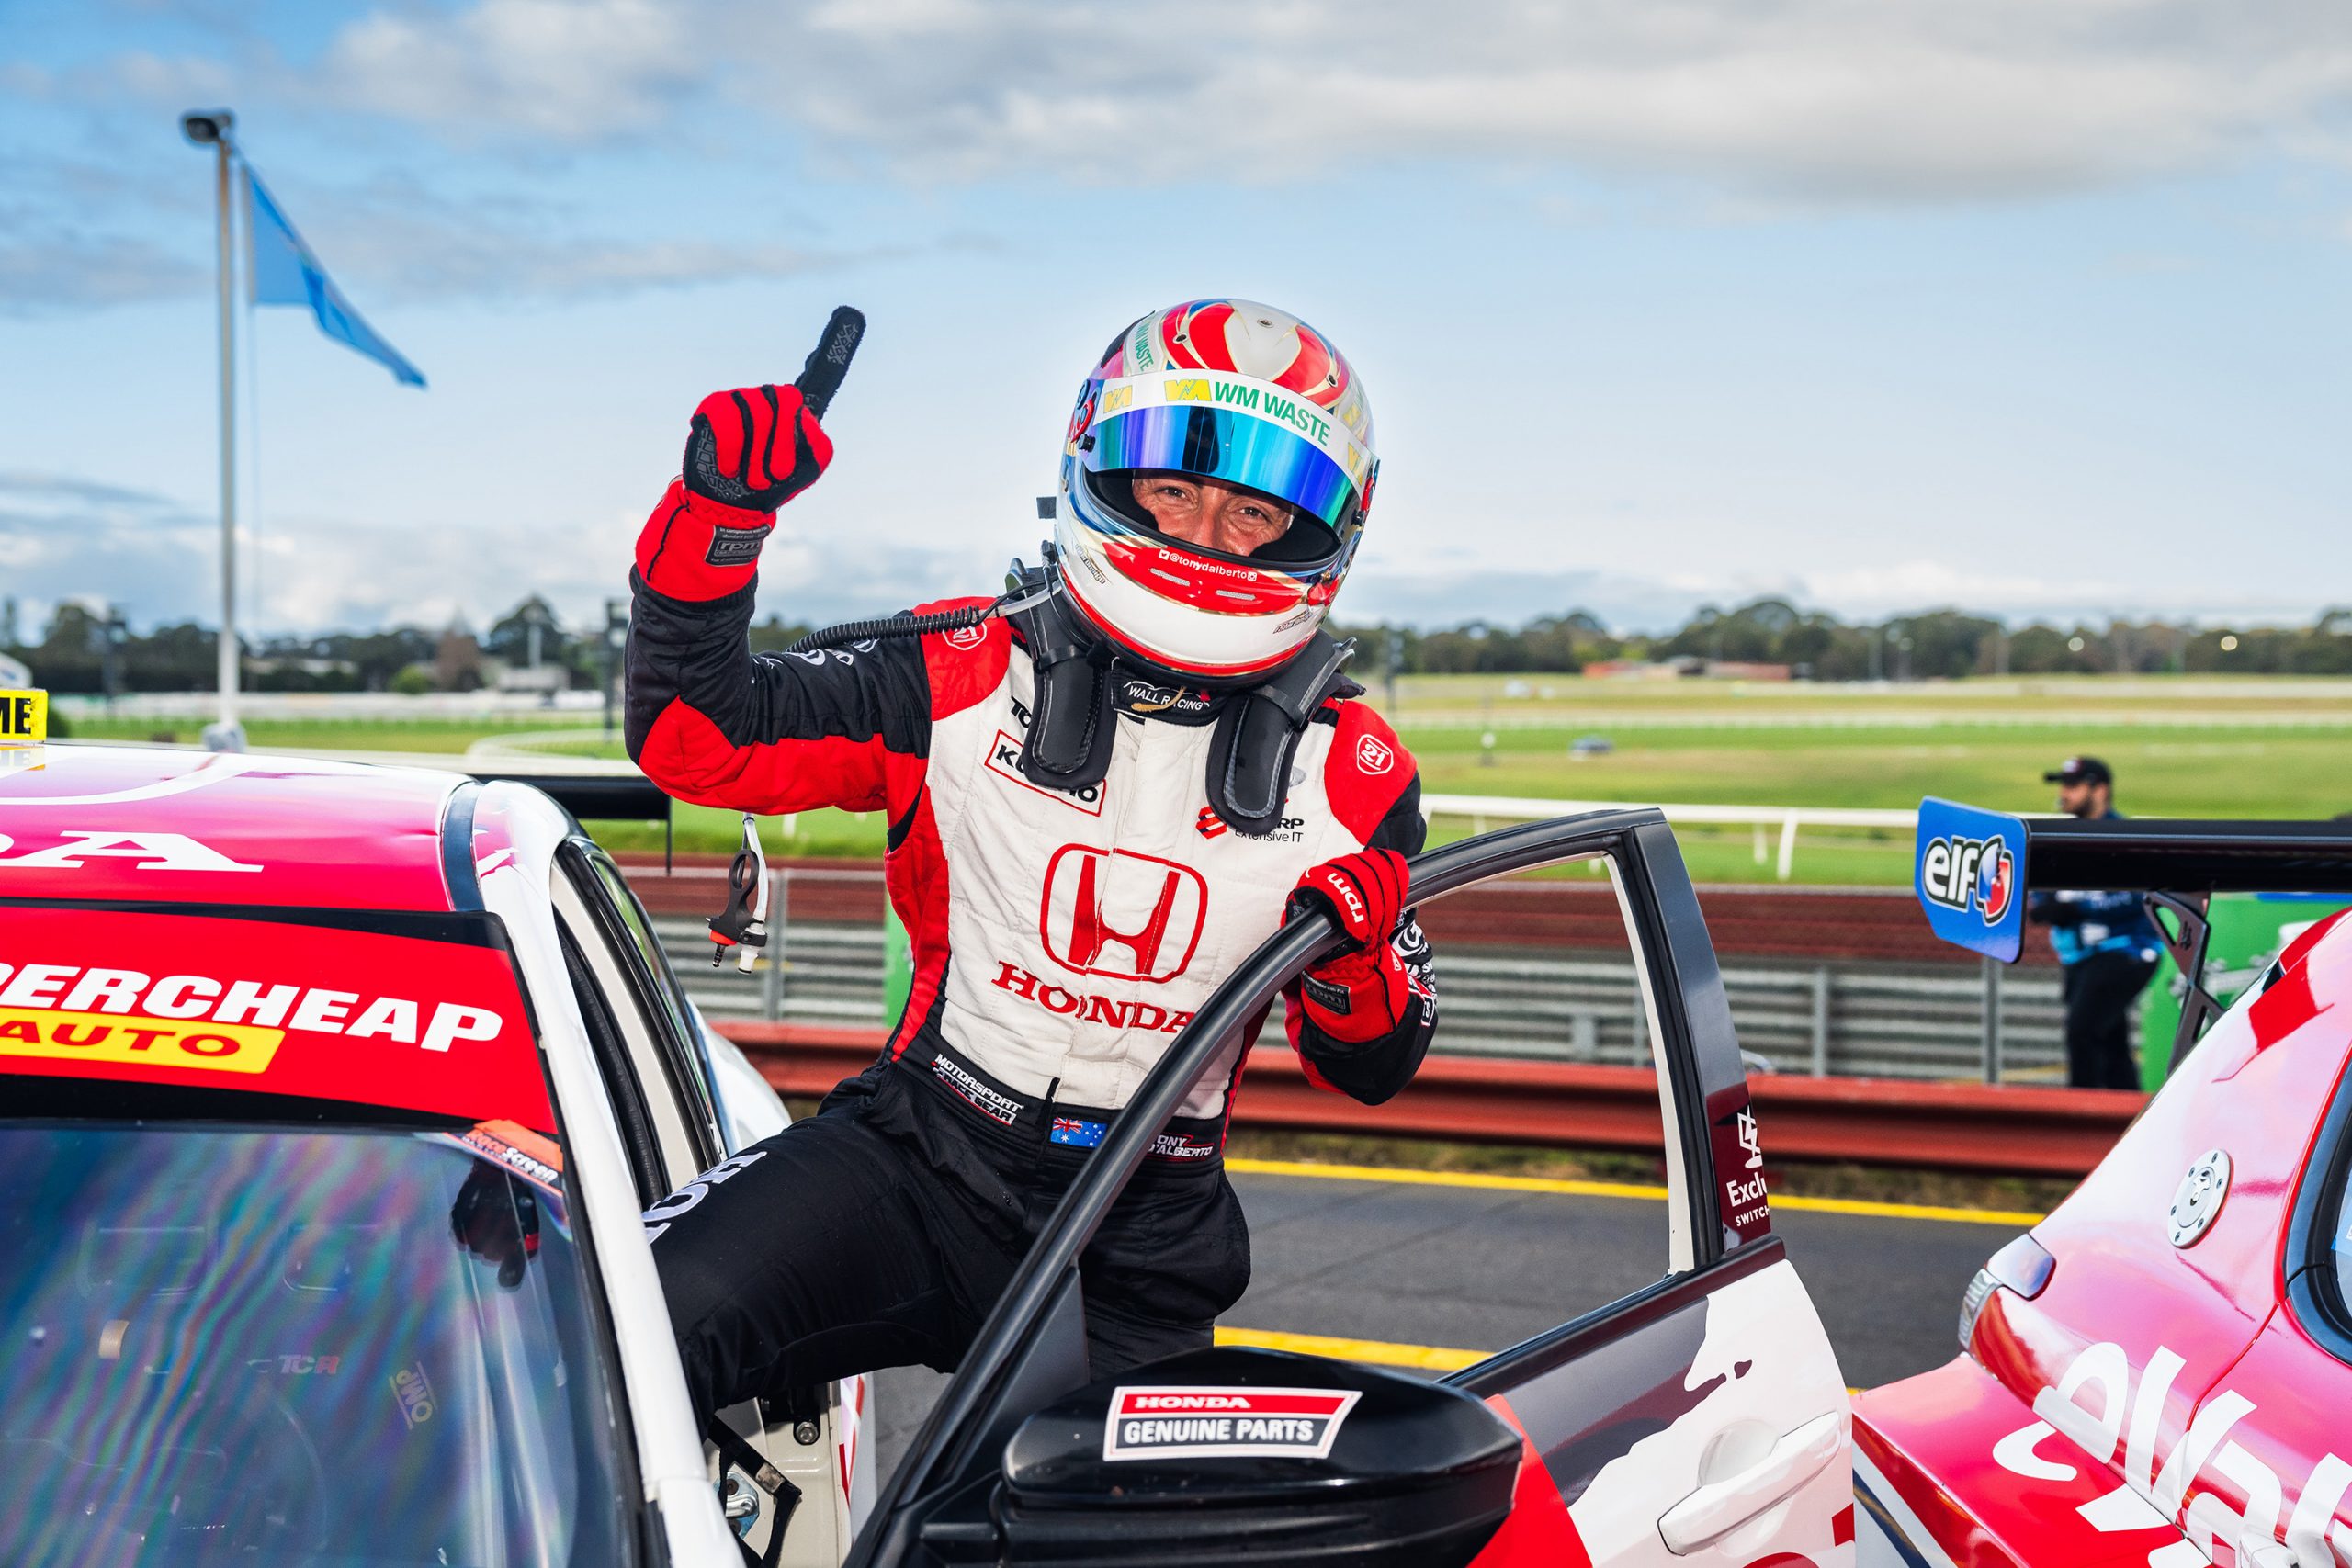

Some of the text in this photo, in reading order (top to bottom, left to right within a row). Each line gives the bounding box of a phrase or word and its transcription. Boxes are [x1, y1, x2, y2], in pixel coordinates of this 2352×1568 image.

[1215, 381, 1260, 409] WM
[1264, 391, 1330, 446] WASTE
[1170, 553, 1247, 579] @tonydalberto
[1128, 685, 1204, 711] WALL RCING
[1361, 742, 1386, 767] 21
[1292, 831, 1304, 843] IT
[1923, 840, 1981, 905] elf
[1327, 873, 1364, 923] rpm
[991, 960, 1195, 1033] HONDA
[0, 1021, 240, 1056] AUTO
[934, 1054, 1024, 1112] MOTORSPORT
[975, 1097, 1012, 1122] GEAR
[396, 1369, 434, 1423] OMP
[1135, 1396, 1251, 1409] HONDA
[1124, 1419, 1314, 1444] GENUINE PARTS
